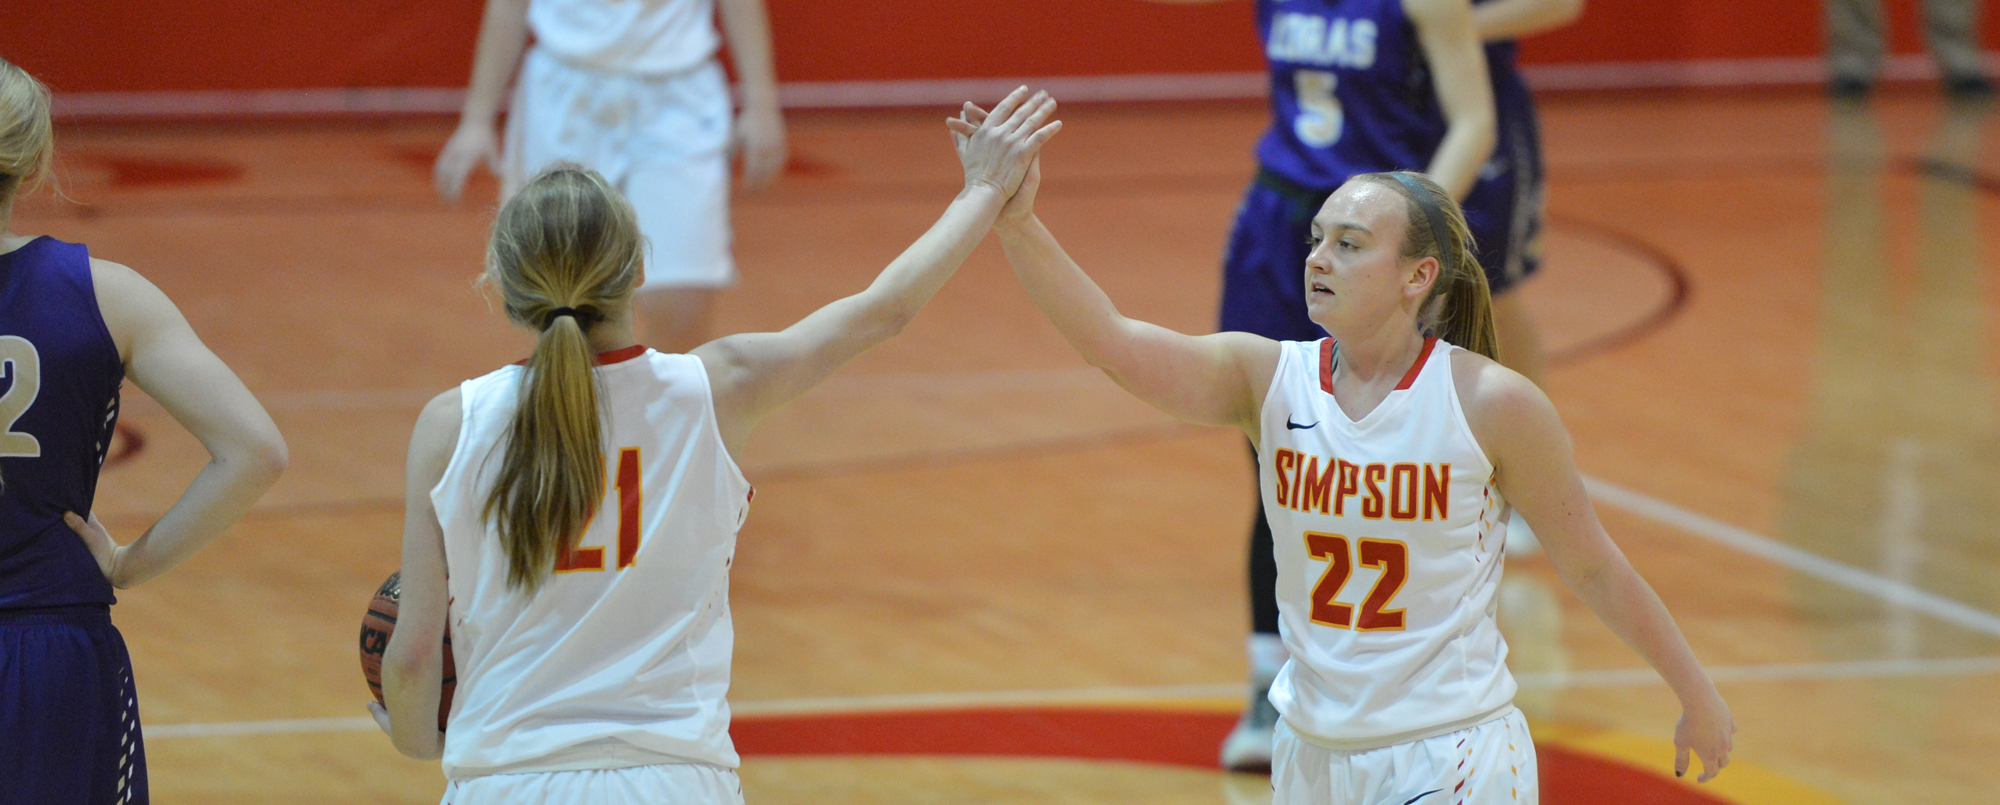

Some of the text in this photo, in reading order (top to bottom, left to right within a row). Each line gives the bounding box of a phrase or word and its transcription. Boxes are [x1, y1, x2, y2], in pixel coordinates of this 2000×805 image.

[1294, 69, 1344, 149] 5
[0, 334, 41, 458] 2
[1275, 446, 1451, 522] SIMPSON
[1303, 530, 1409, 632] 22
